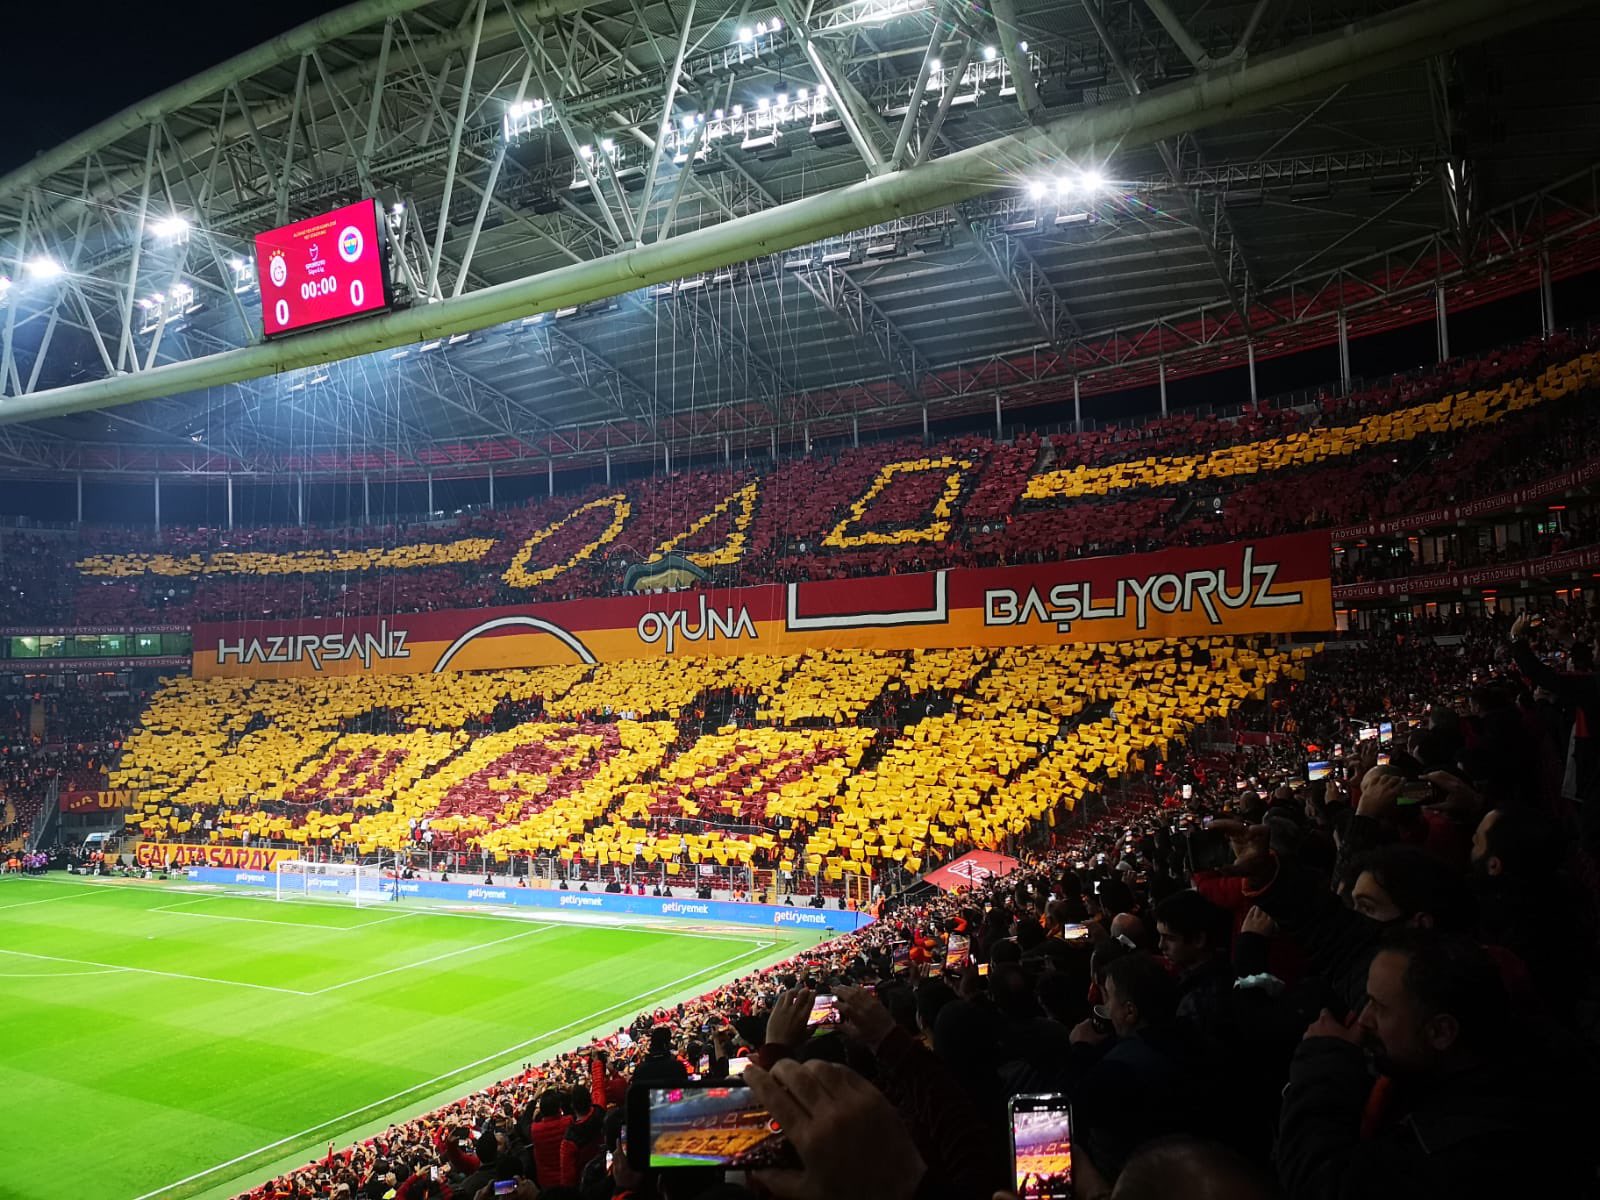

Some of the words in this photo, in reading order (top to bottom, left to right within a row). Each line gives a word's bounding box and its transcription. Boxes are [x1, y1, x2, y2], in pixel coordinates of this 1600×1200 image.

[301, 275, 337, 300] 00:00
[349, 279, 364, 306] 0
[275, 299, 289, 325] 0
[1331, 525, 1368, 540] TADYUMU
[216, 619, 410, 671] HAZIRSANIZ
[637, 594, 758, 653] OYUNA
[984, 546, 1303, 633] BAŞLIYORUZ
[137, 843, 277, 871] GALATASARAY
[661, 902, 709, 914] getiryemek
[774, 910, 826, 924] getiryemek
